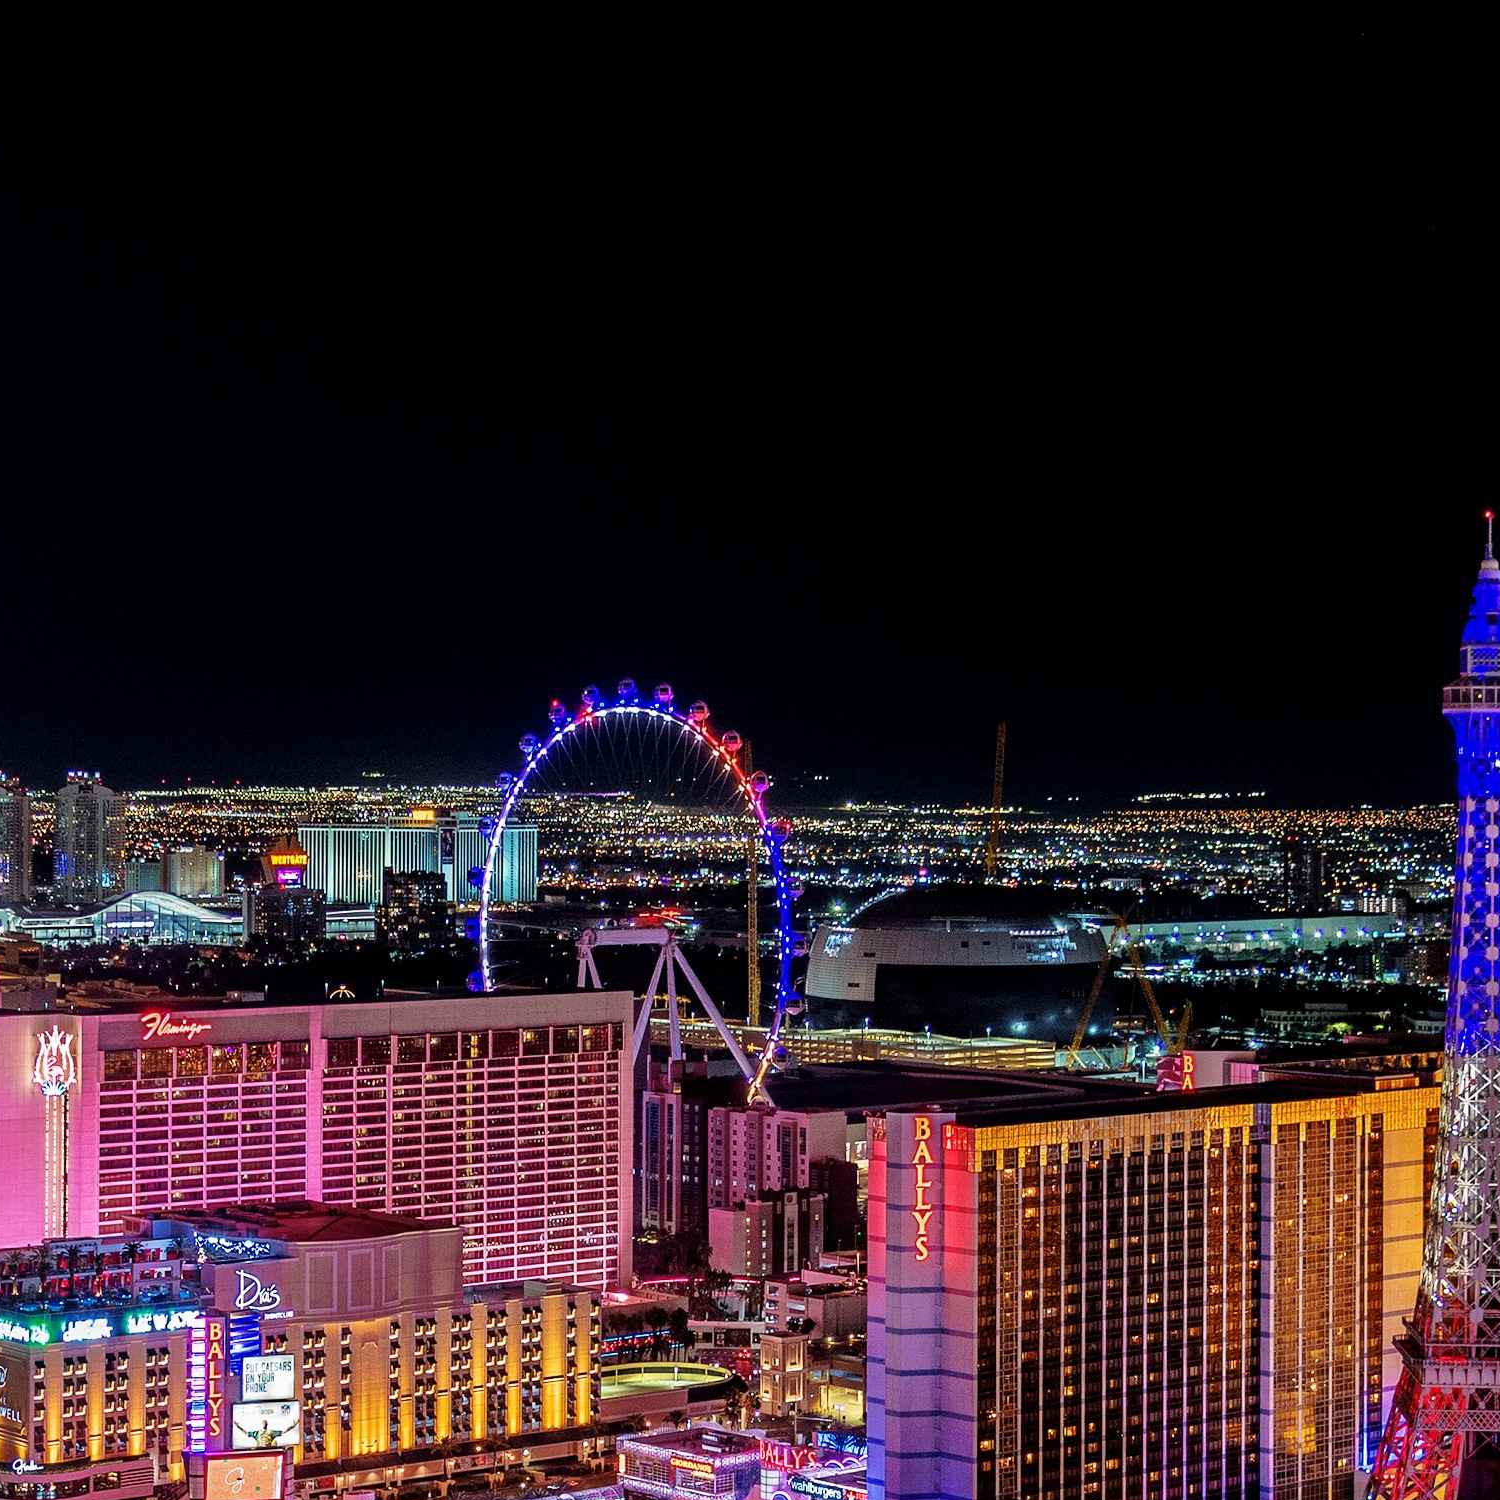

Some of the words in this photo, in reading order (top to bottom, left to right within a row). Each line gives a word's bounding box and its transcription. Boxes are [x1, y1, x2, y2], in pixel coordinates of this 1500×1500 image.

[270, 854, 309, 865] WESTGATE
[141, 1013, 212, 1040] Flamingo
[912, 1117, 933, 1261] BALLYS
[235, 1269, 281, 1311] Drai's
[245, 1363, 259, 1373] PUT
[262, 1361, 292, 1372] CAESARS
[245, 1374, 255, 1383] ON
[257, 1372, 275, 1383] YOUR
[208, 1322, 224, 1436] BALLYS
[245, 1382, 267, 1393] PHONE
[759, 1440, 817, 1470] BALLY'S
[791, 1481, 842, 1499] wahlburgers
